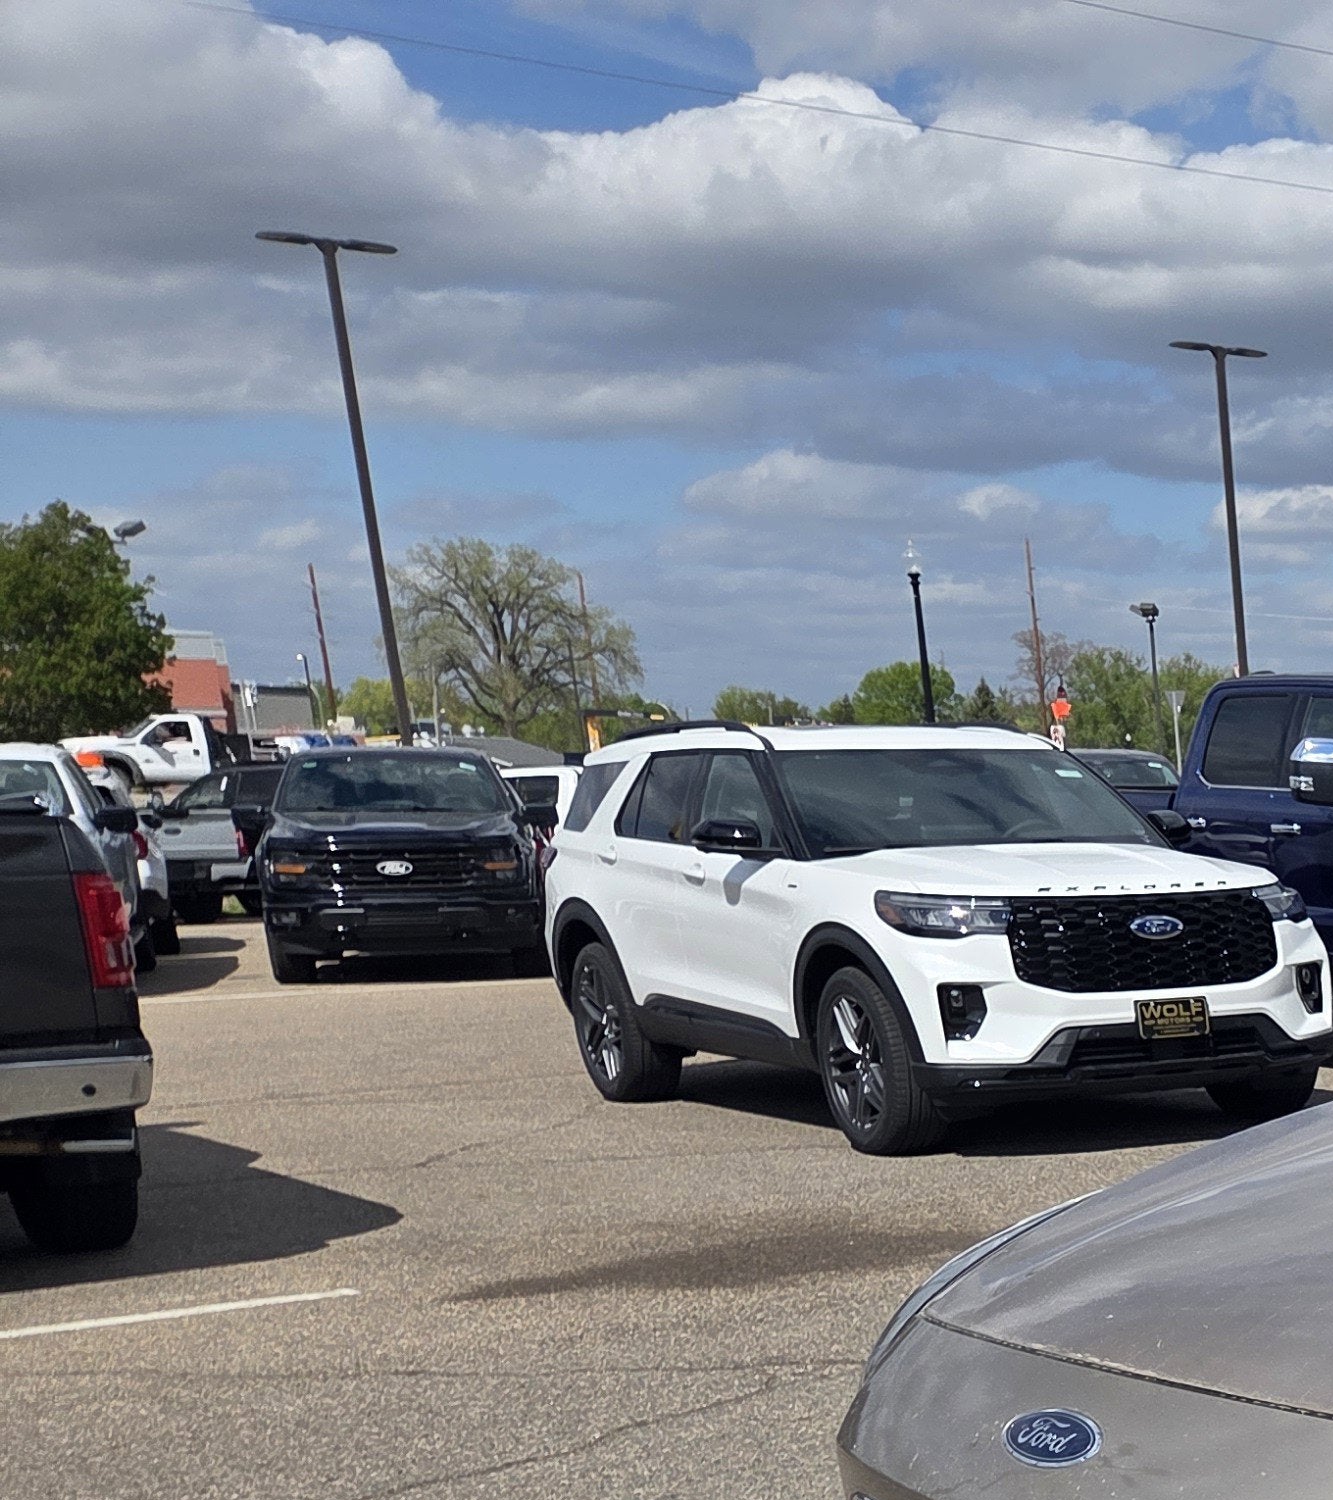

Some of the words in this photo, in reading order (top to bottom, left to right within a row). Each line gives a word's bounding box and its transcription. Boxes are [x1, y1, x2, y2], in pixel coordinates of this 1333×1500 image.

[1038, 880, 1227, 892] EXPLORER
[1141, 1002, 1203, 1019] WOLF
[1017, 1417, 1078, 1454] Ford
